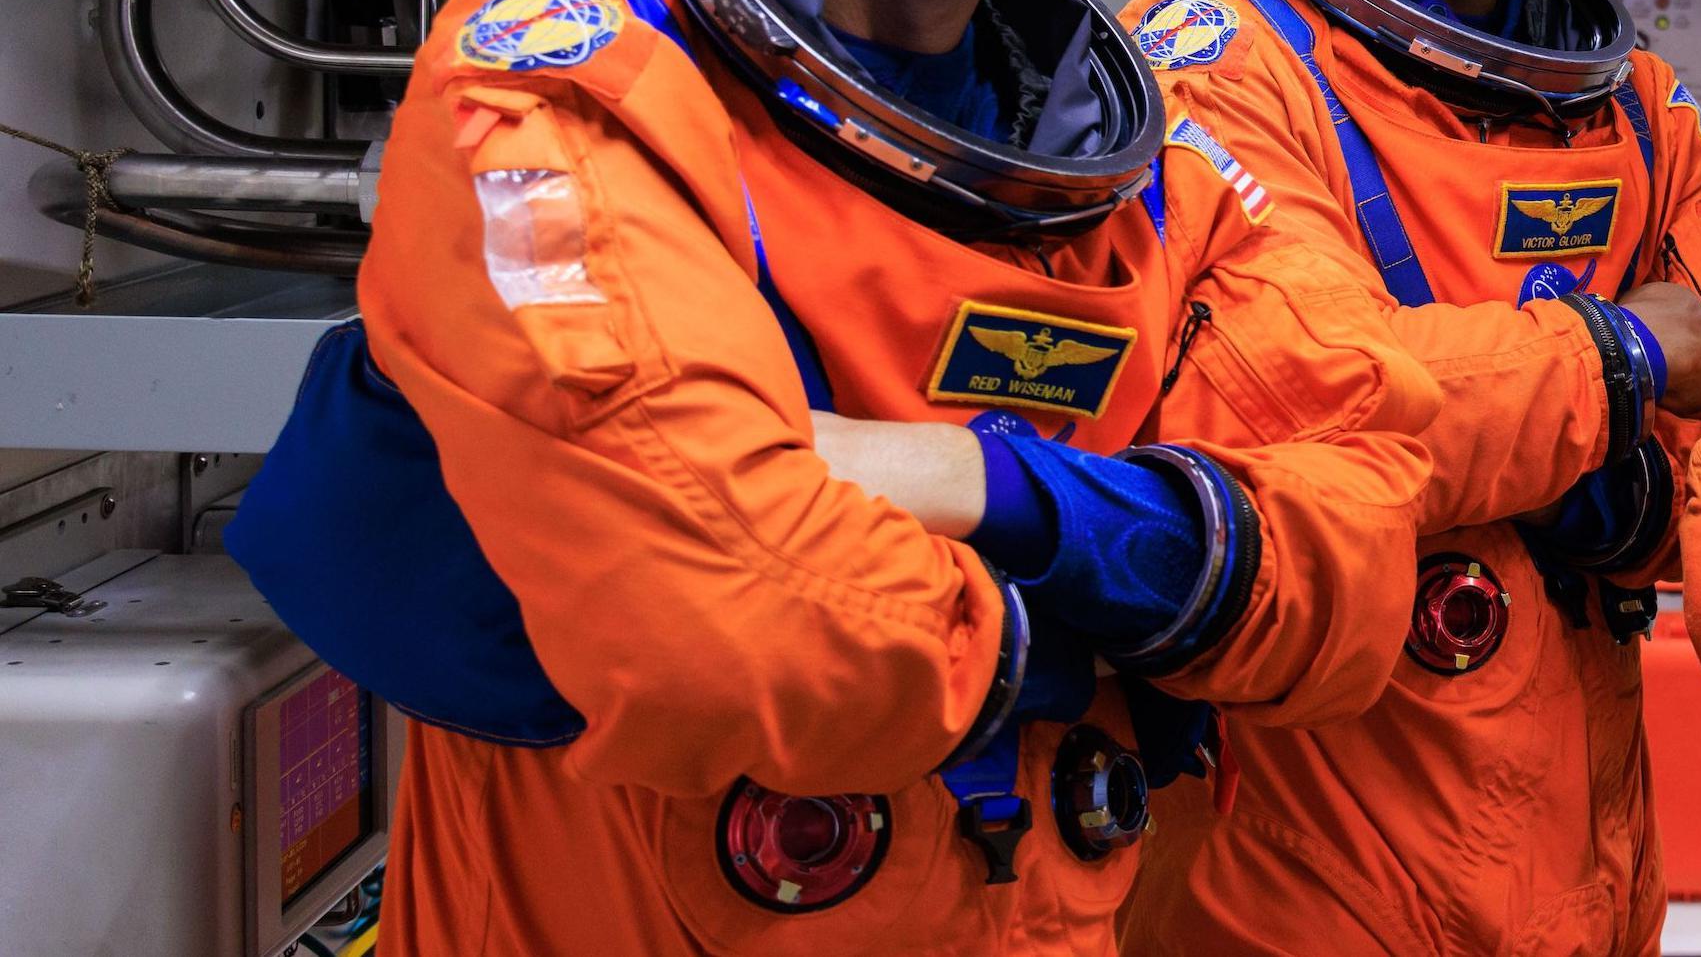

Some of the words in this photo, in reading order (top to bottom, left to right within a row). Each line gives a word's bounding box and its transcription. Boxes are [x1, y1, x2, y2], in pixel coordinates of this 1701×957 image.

[1522, 236, 1555, 249] VICTOR
[1559, 233, 1592, 247] GLOVER
[968, 375, 1001, 391] REID
[1008, 379, 1076, 403] WISEMAN
